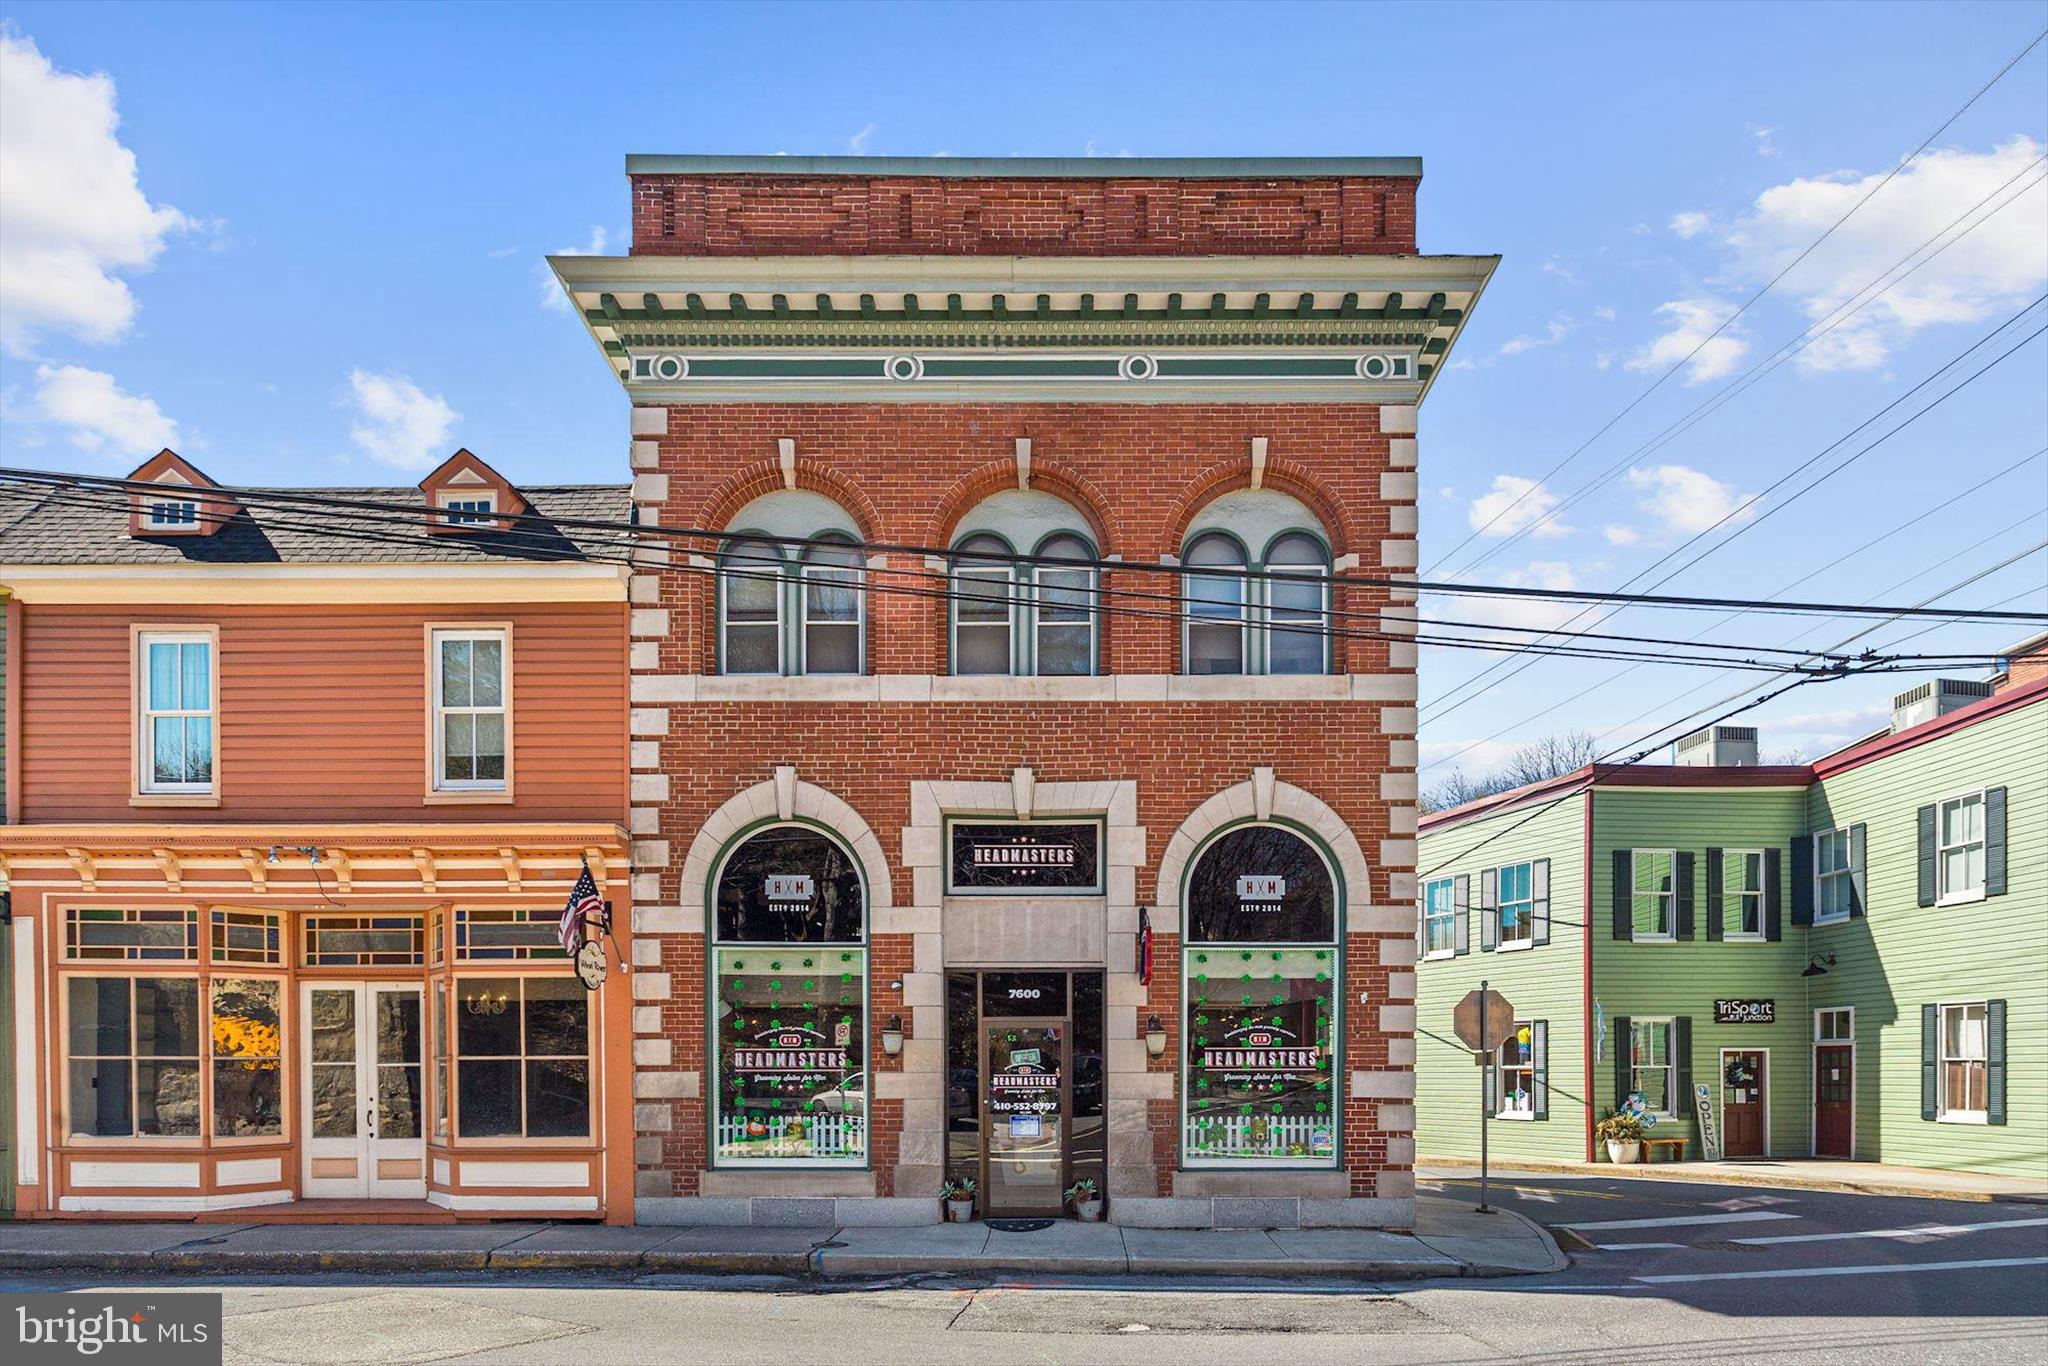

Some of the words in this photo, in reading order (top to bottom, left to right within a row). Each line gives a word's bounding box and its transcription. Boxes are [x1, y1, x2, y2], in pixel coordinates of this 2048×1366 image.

[974, 848, 1074, 863] HEADMASTERS
[774, 880, 781, 894] H
[795, 880, 804, 894] M
[1246, 880, 1253, 894] H
[1268, 880, 1276, 894] M
[790, 904, 809, 912] 2014
[1262, 904, 1281, 912] 2014
[1008, 989, 1041, 999] 7600
[1717, 1001, 1772, 1017] TriSport
[735, 1052, 847, 1068] HEADMASTERS
[1204, 1051, 1317, 1067] HEADMASTERS
[993, 1076, 1057, 1086] HEADMASTERS
[993, 1102, 1057, 1111] 410-552-8797
[1699, 1100, 1715, 1148] OPEN
